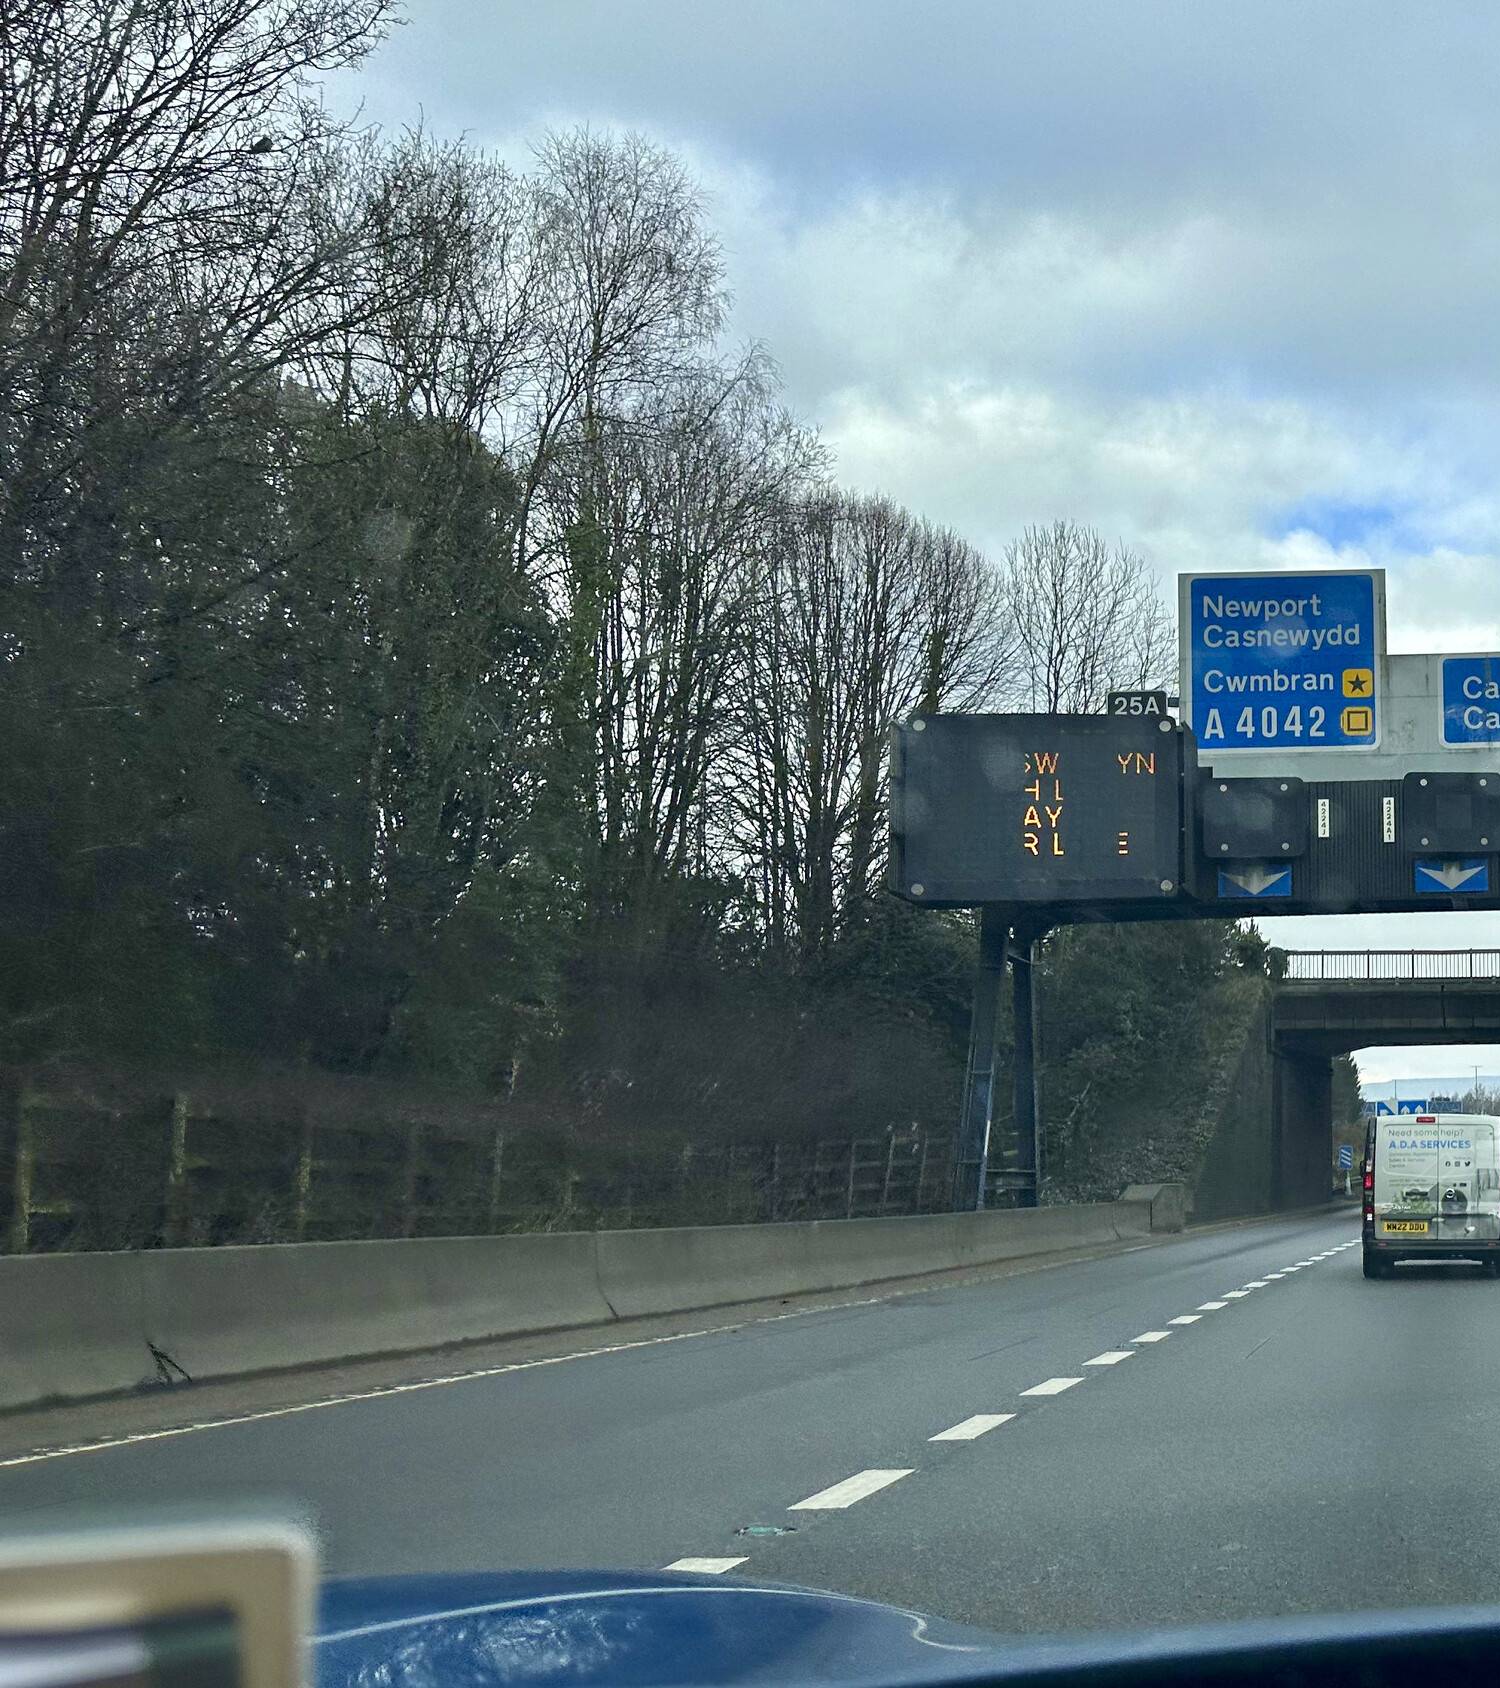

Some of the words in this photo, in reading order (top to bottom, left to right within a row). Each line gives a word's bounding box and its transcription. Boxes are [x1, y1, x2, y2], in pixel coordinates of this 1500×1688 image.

[1203, 594, 1321, 622] Newport
[1203, 623, 1360, 650] Casnewydd
[1203, 668, 1334, 693] Cwmbran
[1114, 696, 1161, 716] 25A
[1236, 705, 1326, 738] 4042
[1117, 752, 1156, 774] YN
[1388, 1129, 1412, 1137] Need
[1420, 1140, 1471, 1149] SERVICES
